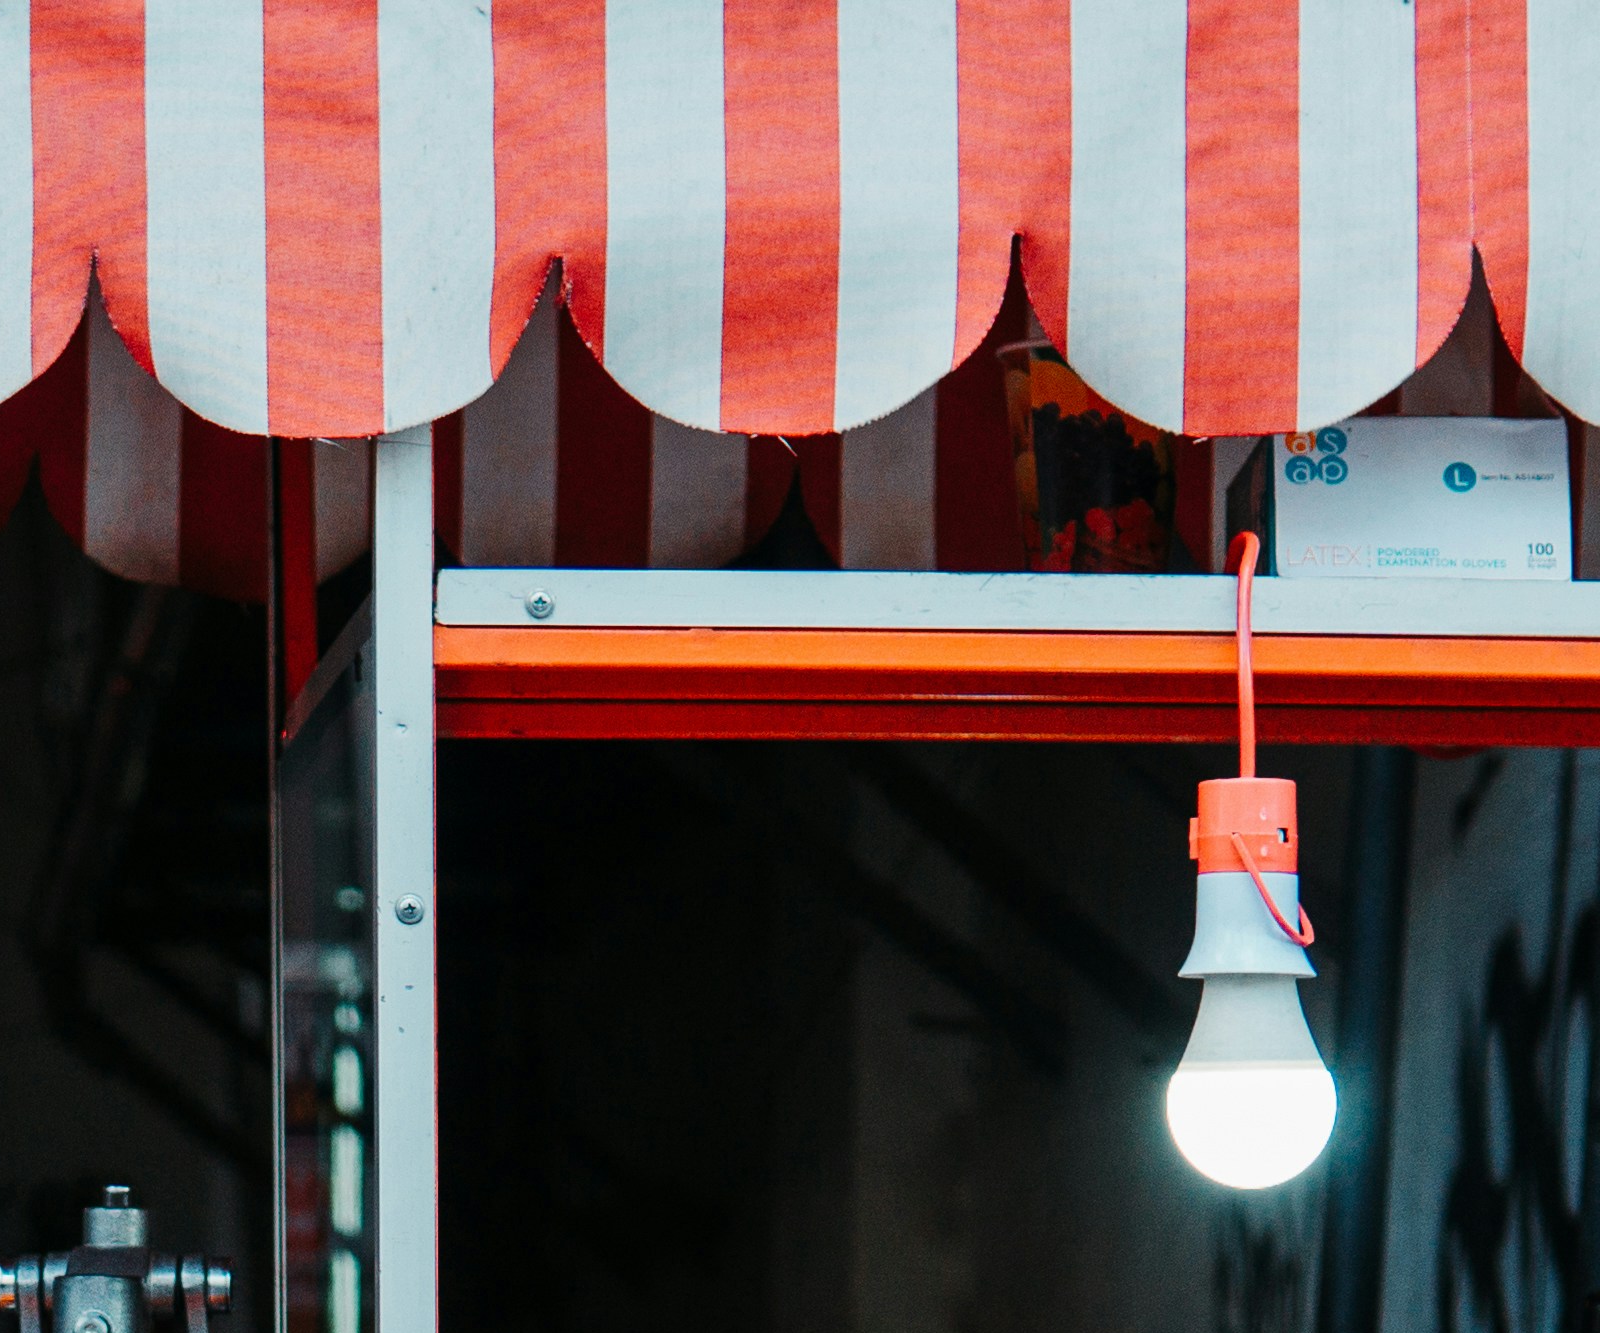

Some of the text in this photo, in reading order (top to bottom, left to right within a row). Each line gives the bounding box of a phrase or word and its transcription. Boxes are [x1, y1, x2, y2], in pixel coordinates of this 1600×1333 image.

[1453, 469, 1468, 488] L
[1286, 543, 1362, 566] LATEX
[1376, 547, 1440, 557] POWDERED
[1527, 542, 1554, 556] 100
[1376, 557, 1507, 569] EXAMINATION GLOVES
